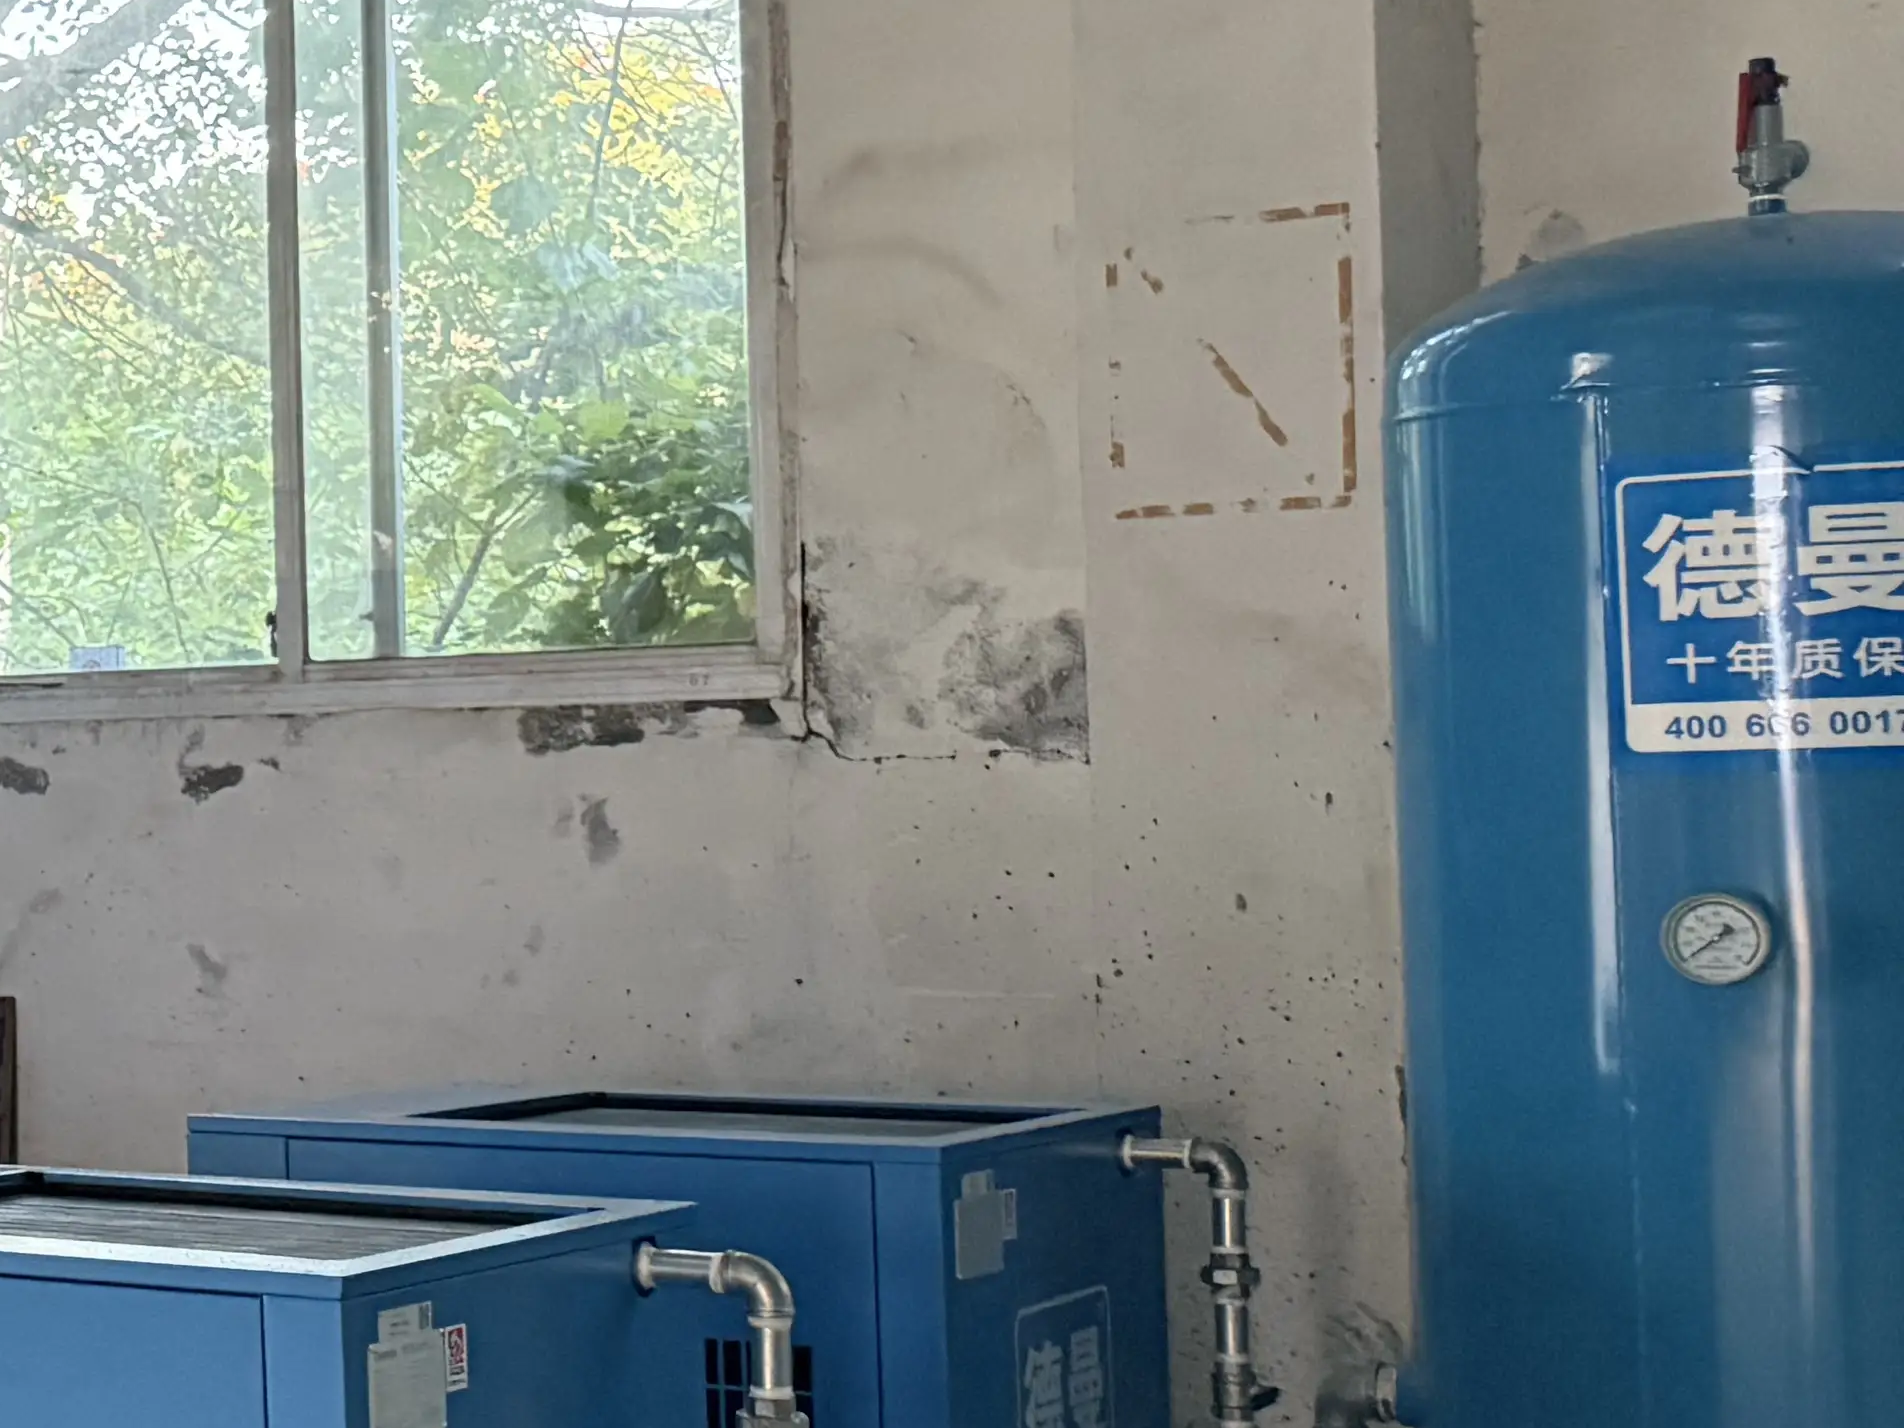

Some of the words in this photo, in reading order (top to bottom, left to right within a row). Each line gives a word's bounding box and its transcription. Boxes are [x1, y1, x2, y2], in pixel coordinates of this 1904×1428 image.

[1642, 502, 1904, 622] 德曼
[1665, 636, 1904, 684] 十年质保
[1664, 714, 1727, 740] 400
